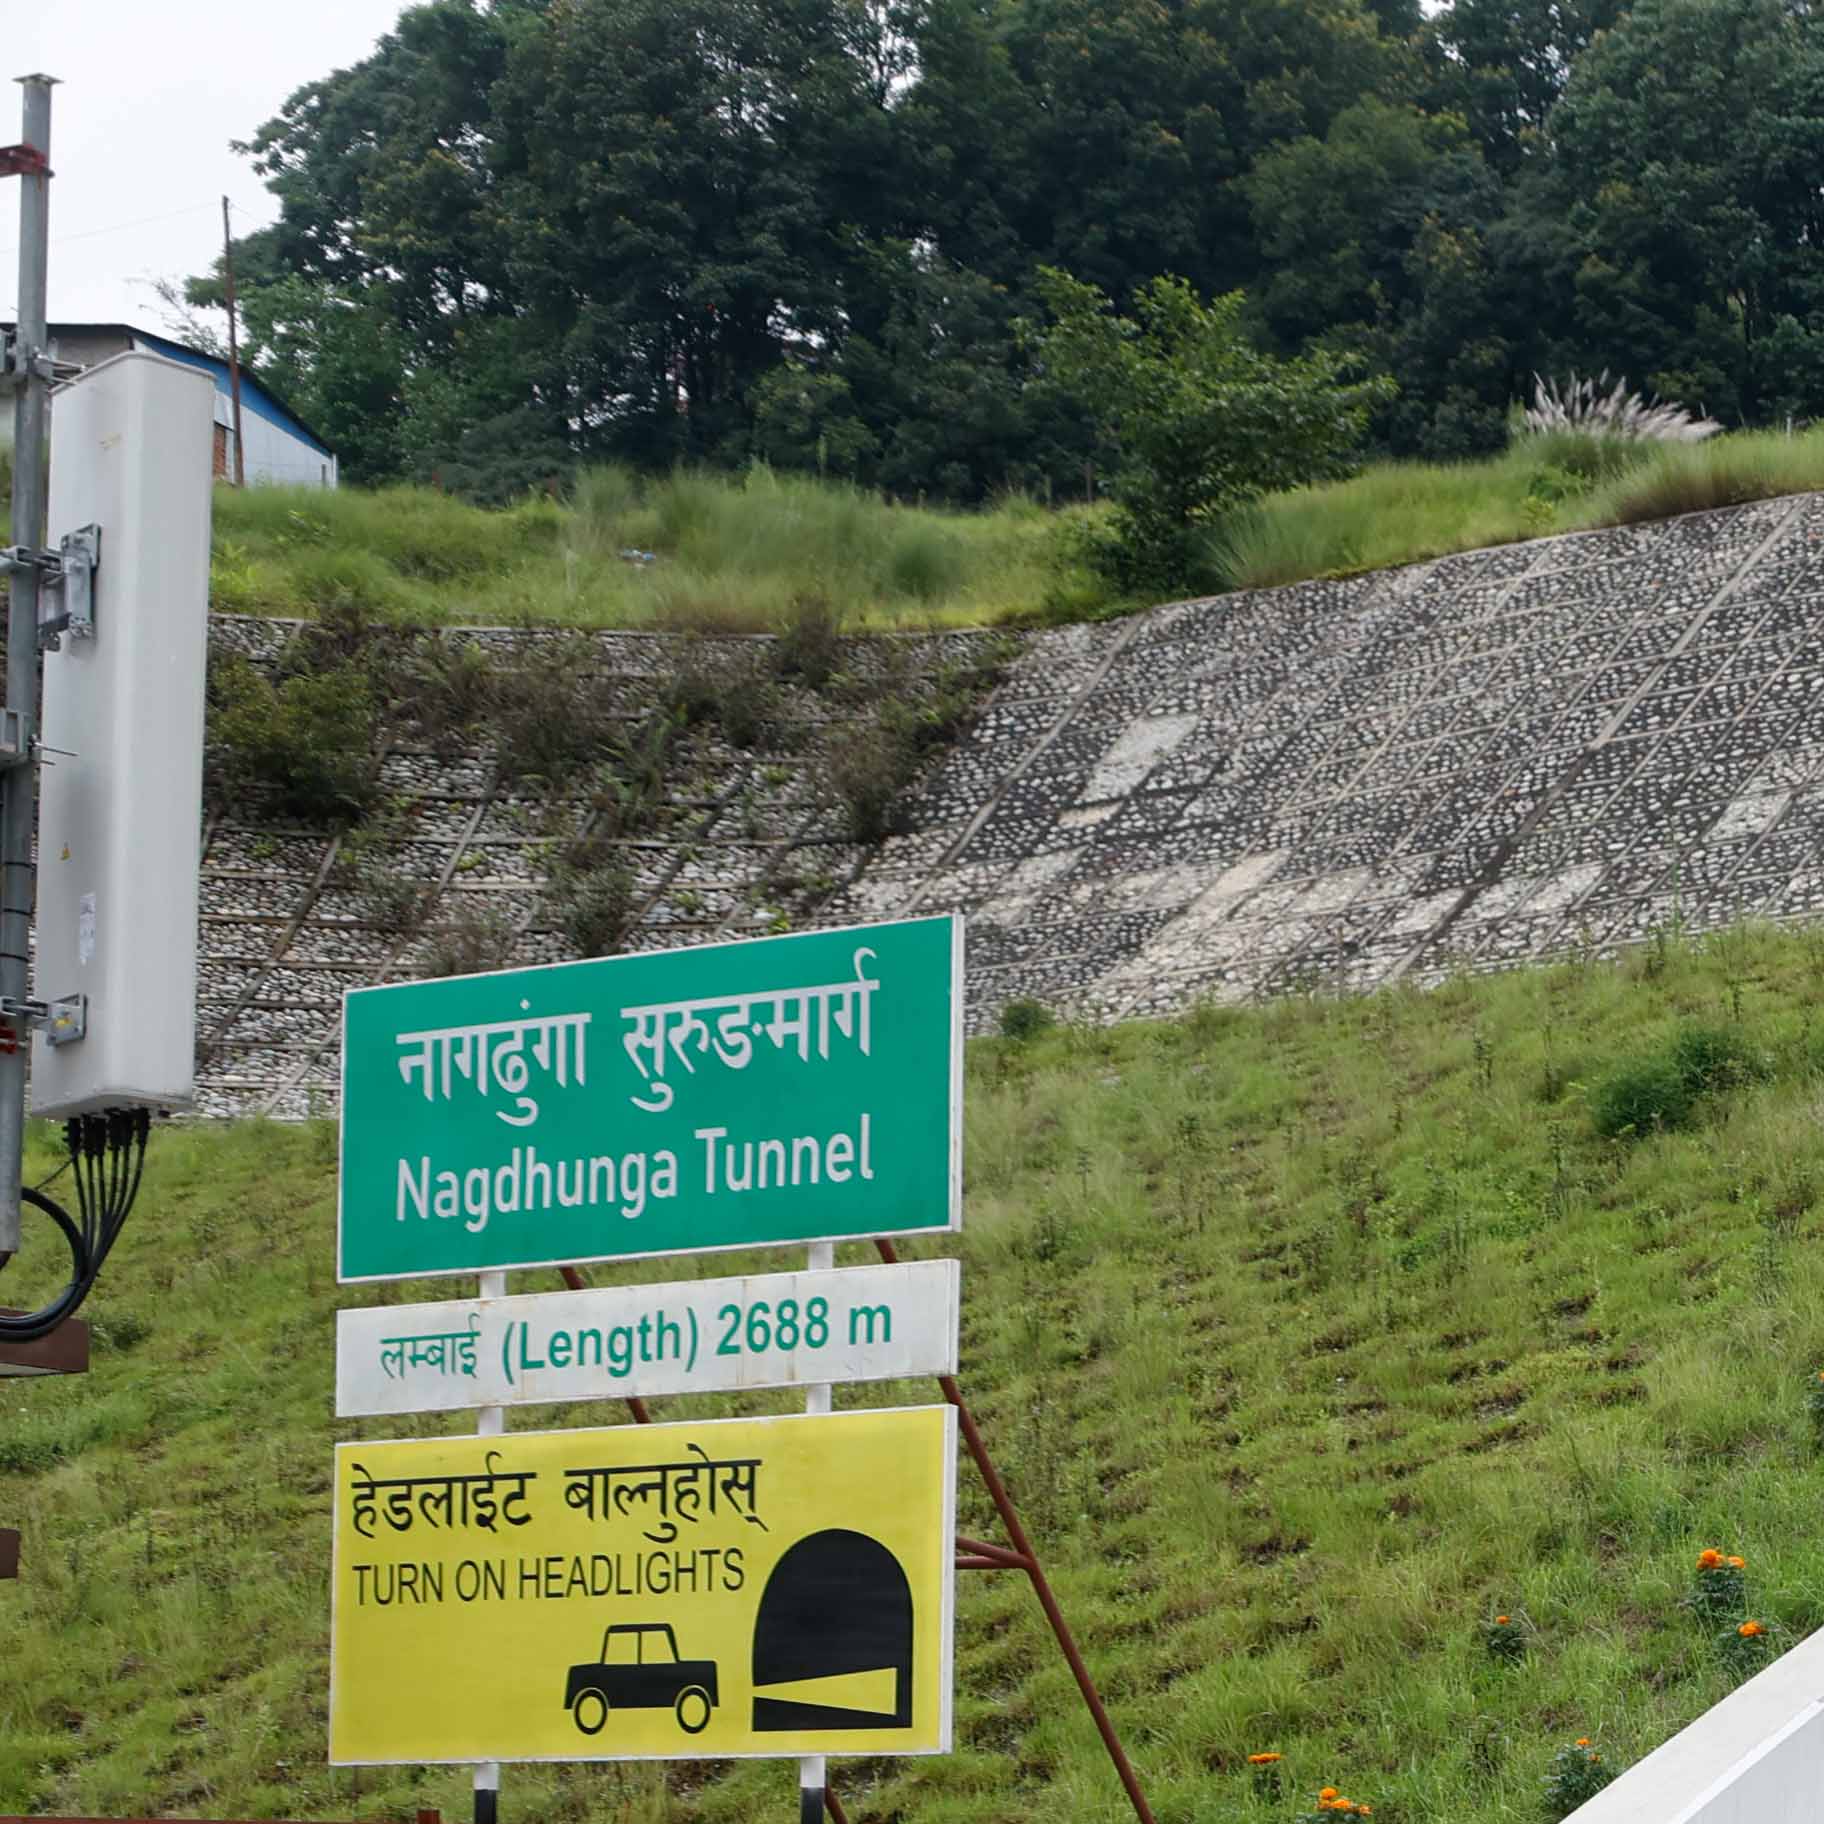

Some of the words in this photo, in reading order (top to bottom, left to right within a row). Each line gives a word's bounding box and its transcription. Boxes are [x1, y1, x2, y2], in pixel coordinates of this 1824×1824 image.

[396, 998, 592, 1127] नागढुंगा
[396, 1146, 678, 1233] Nagdhunga
[694, 1113, 875, 1194] Tunnel
[379, 1312, 481, 1380] लम्बाई
[502, 1306, 699, 1386] (Length)
[715, 1296, 830, 1356] 2688
[849, 1304, 892, 1346] m
[351, 1450, 538, 1539] हेडलाईट
[564, 1443, 769, 1544] बाल्नुहोस्
[351, 1561, 445, 1606] TURN
[455, 1559, 506, 1602] ON
[519, 1547, 745, 1599] HEADLIGHTS
